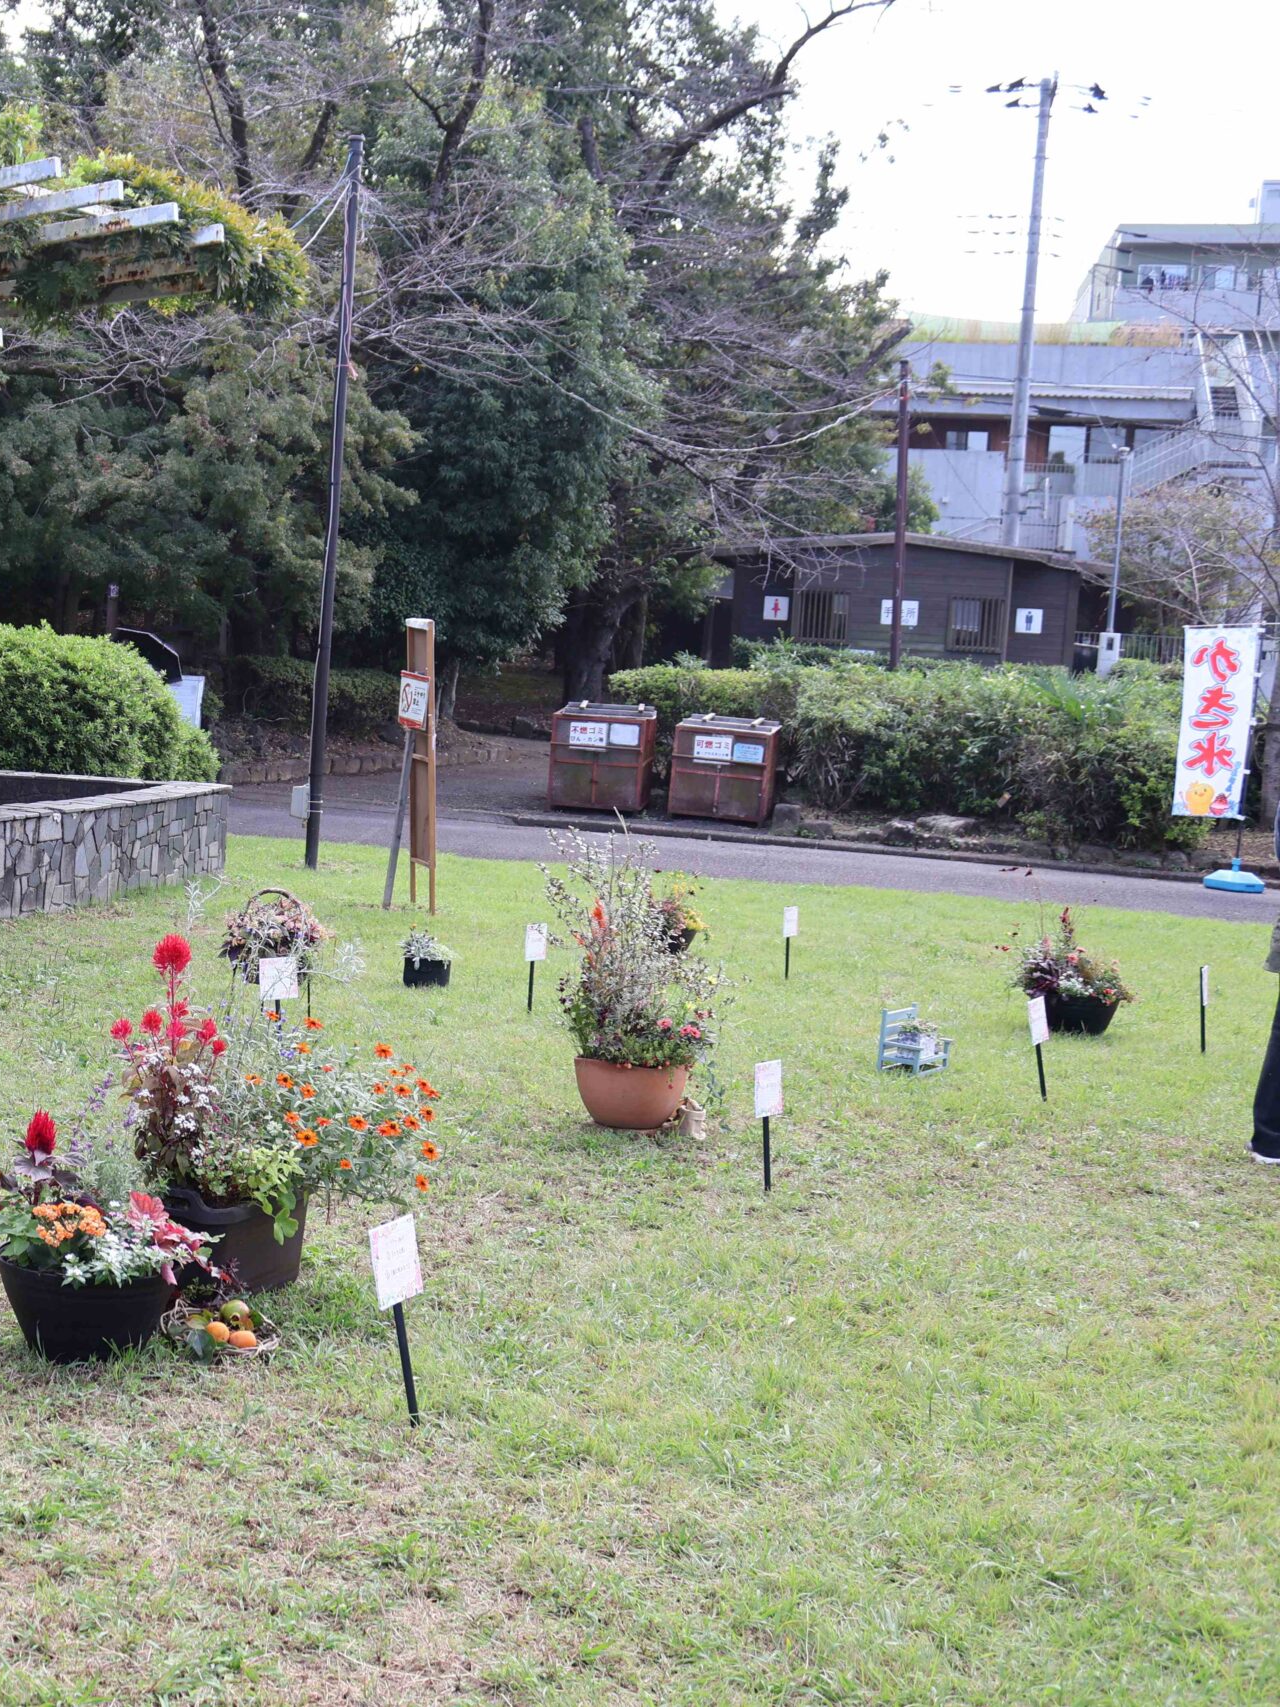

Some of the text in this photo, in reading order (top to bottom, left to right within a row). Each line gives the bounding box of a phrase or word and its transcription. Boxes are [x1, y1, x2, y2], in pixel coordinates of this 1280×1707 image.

[883, 606, 917, 619] 手所
[571, 725, 604, 735] 不燃ゴミ
[696, 740, 730, 750] 可燃ゴミ
